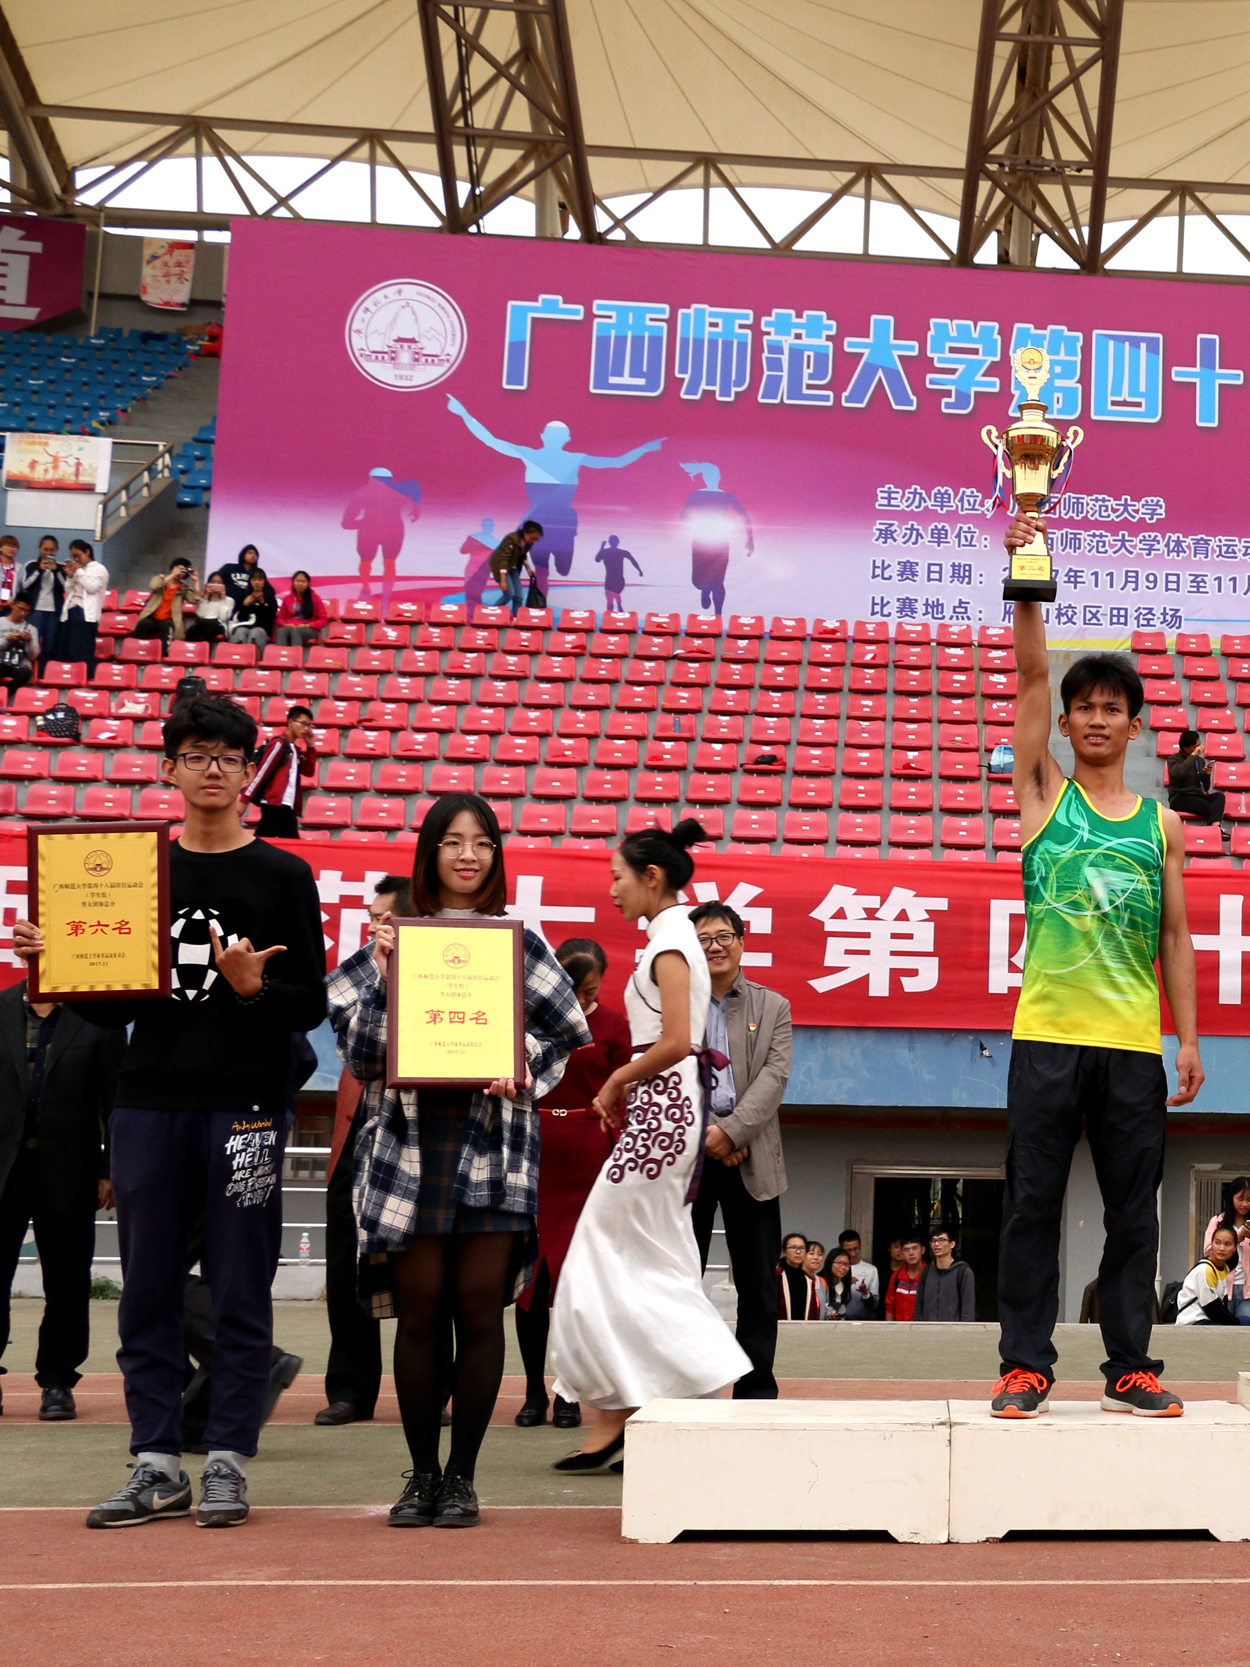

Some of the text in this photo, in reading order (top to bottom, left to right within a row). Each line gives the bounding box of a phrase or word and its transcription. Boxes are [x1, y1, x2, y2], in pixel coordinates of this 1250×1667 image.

[66, 919, 131, 937] 第六名
[425, 1009, 488, 1025] 第四名
[224, 1130, 277, 1155] HEAVEN
[232, 1148, 271, 1170] HELL
[231, 1168, 252, 1181] ARE
